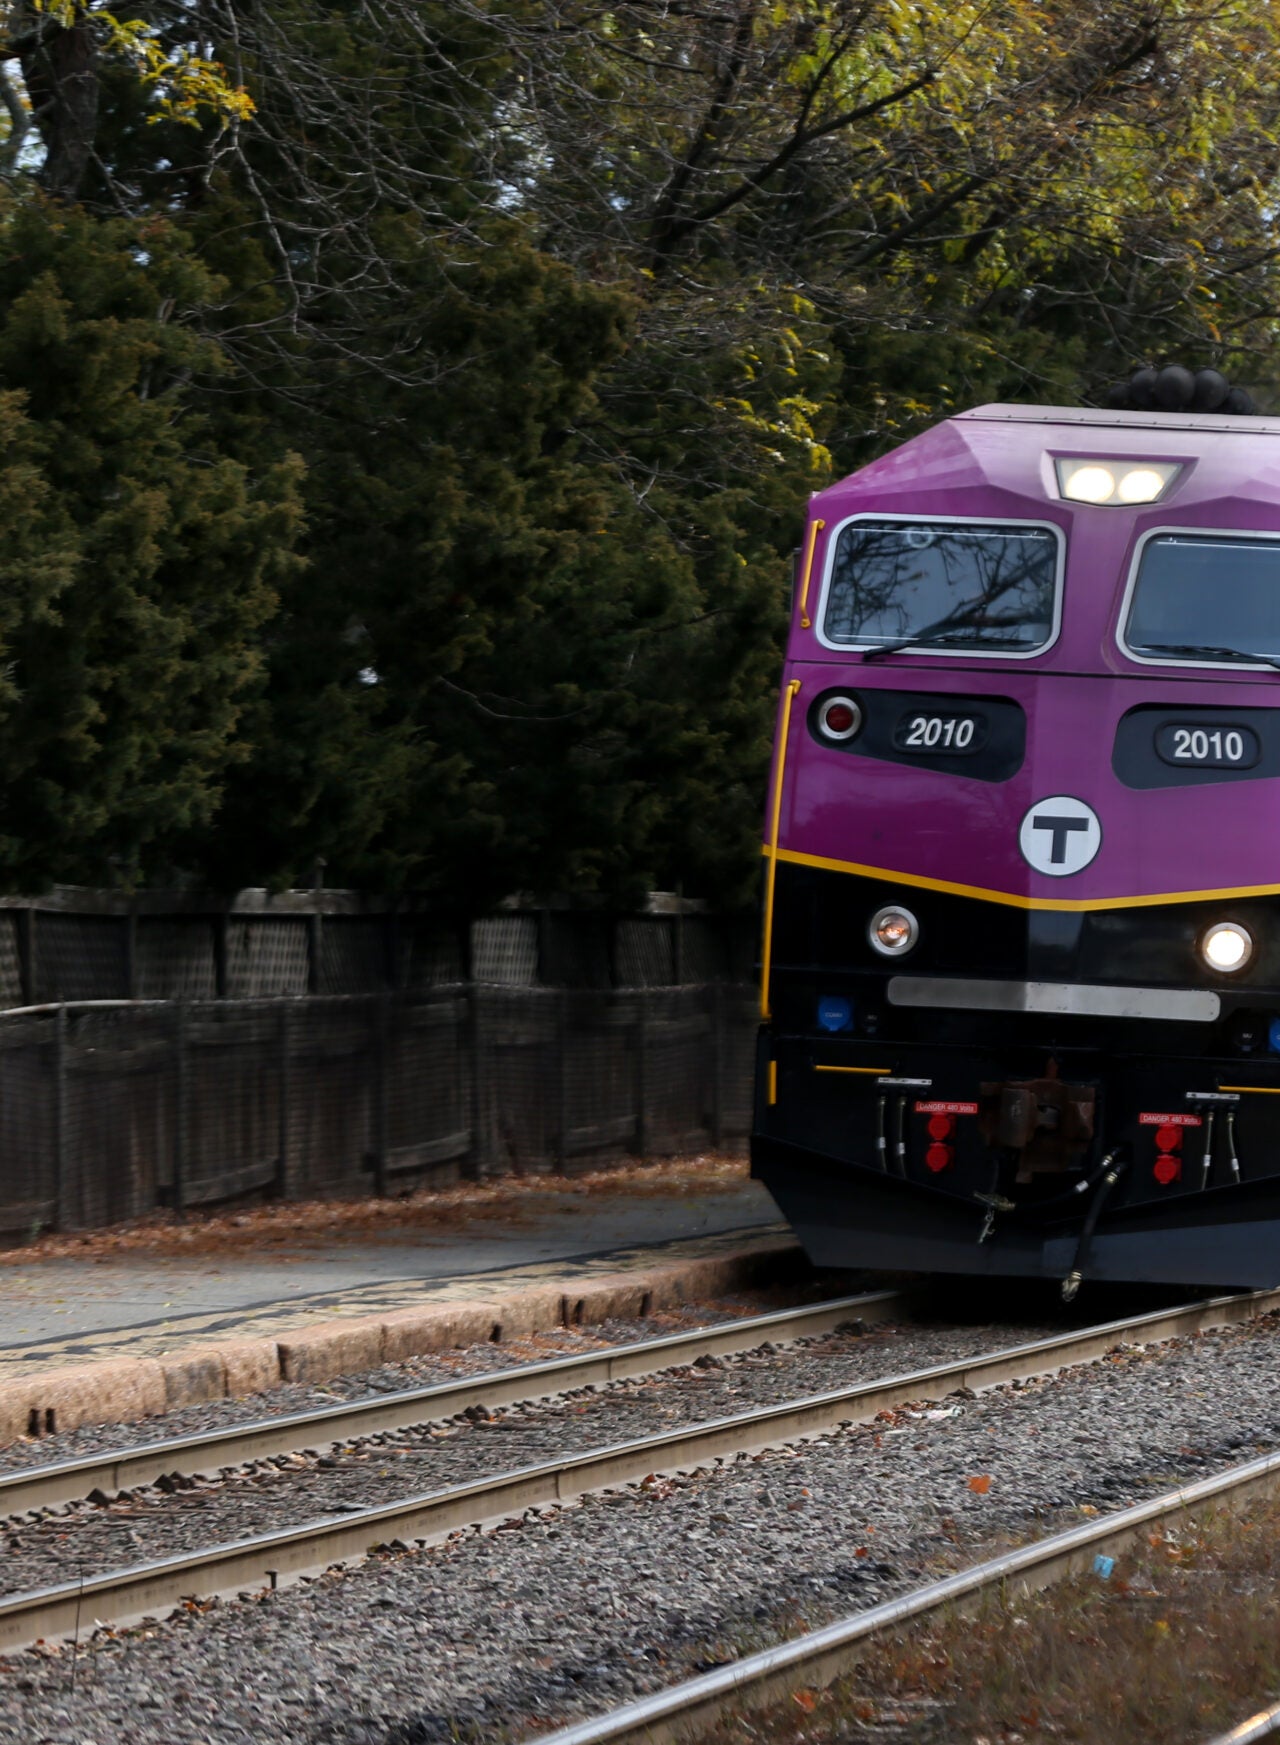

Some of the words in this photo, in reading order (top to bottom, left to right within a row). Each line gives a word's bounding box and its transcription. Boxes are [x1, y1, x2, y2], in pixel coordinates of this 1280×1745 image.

[906, 717, 975, 748] 2010
[1174, 729, 1243, 761] 2010
[1032, 815, 1090, 864] T
[919, 1103, 946, 1111] DANGER
[1143, 1115, 1170, 1123] DANGER
